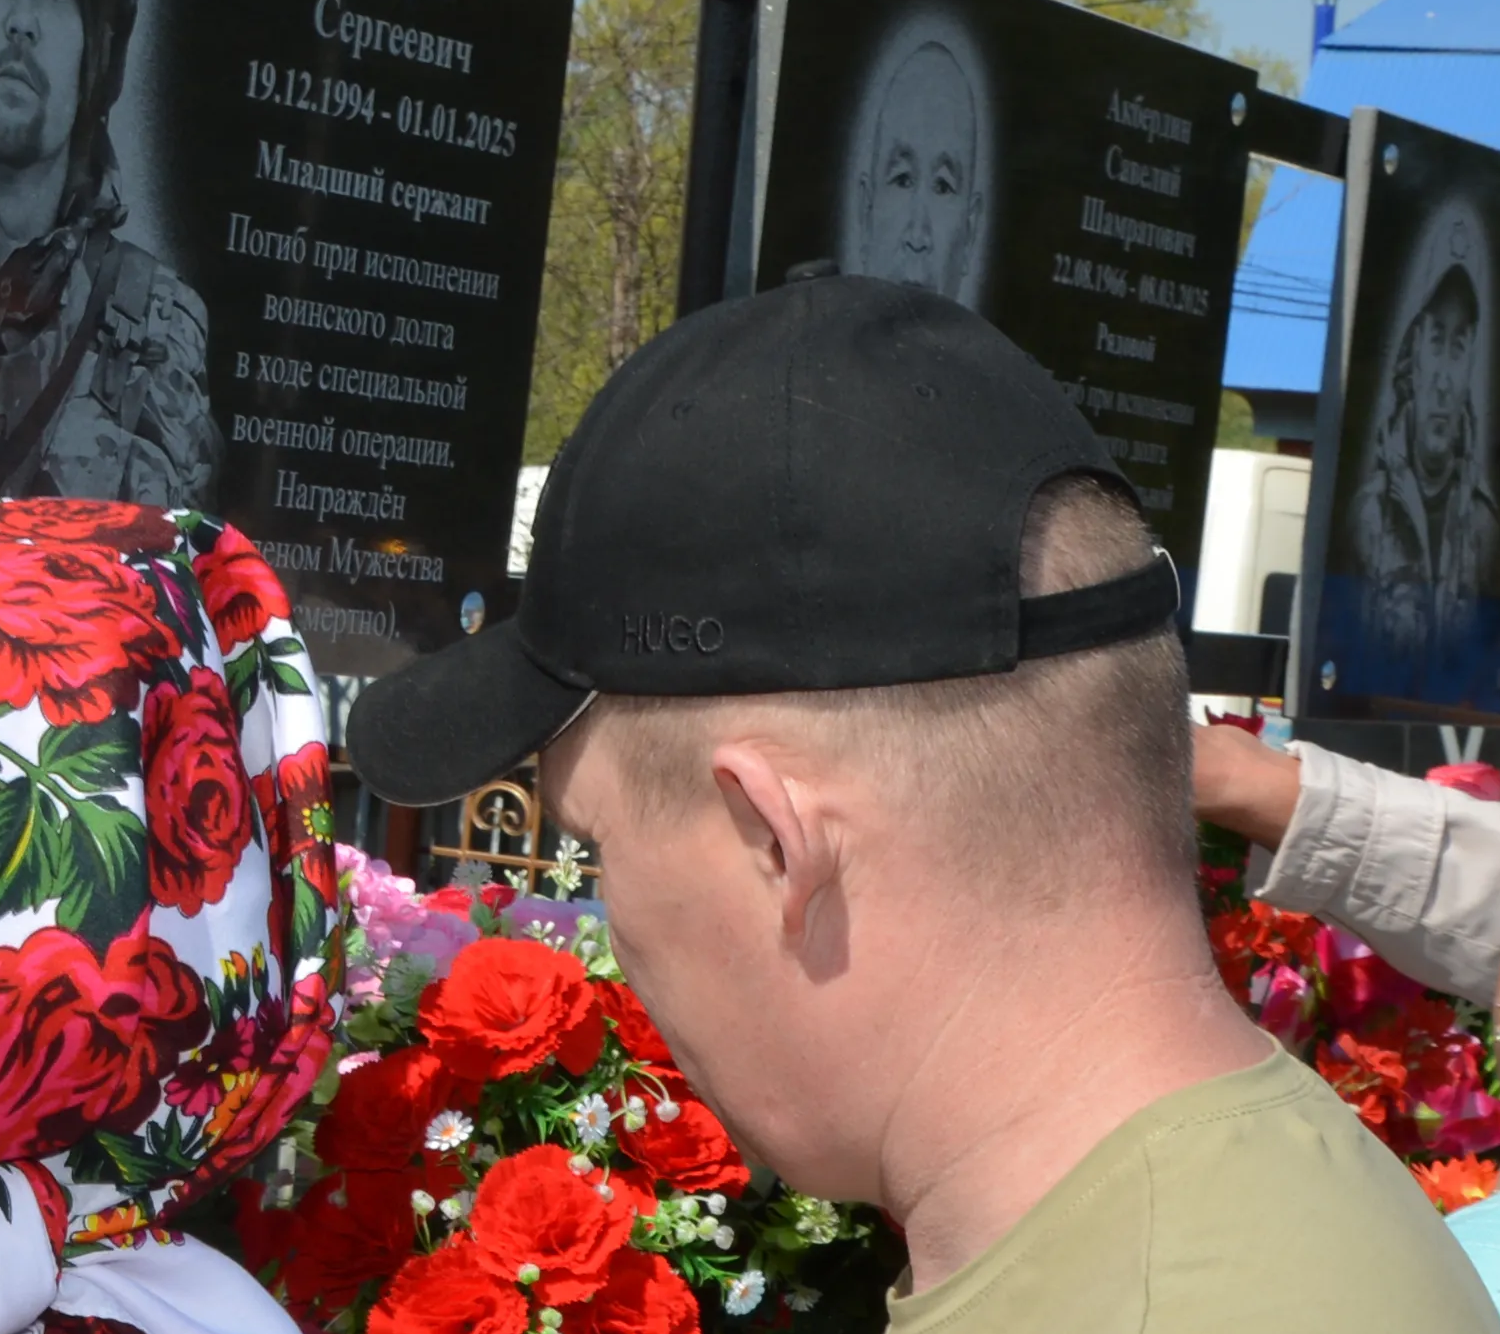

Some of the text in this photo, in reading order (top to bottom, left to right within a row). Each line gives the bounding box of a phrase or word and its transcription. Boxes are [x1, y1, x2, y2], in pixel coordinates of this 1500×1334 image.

[246, 59, 375, 127] 19.12.1994
[398, 95, 518, 158] 01.01.2025
[255, 140, 492, 224] Младший сержант
[226, 212, 500, 300] Погиб при исполнении
[263, 293, 455, 351] воинского долга
[235, 352, 468, 411] в ходе специальной
[232, 413, 455, 469] военной операции.
[273, 469, 407, 522] Награждён
[329, 536, 443, 584] Мужества
[622, 611, 724, 654] HUGO
